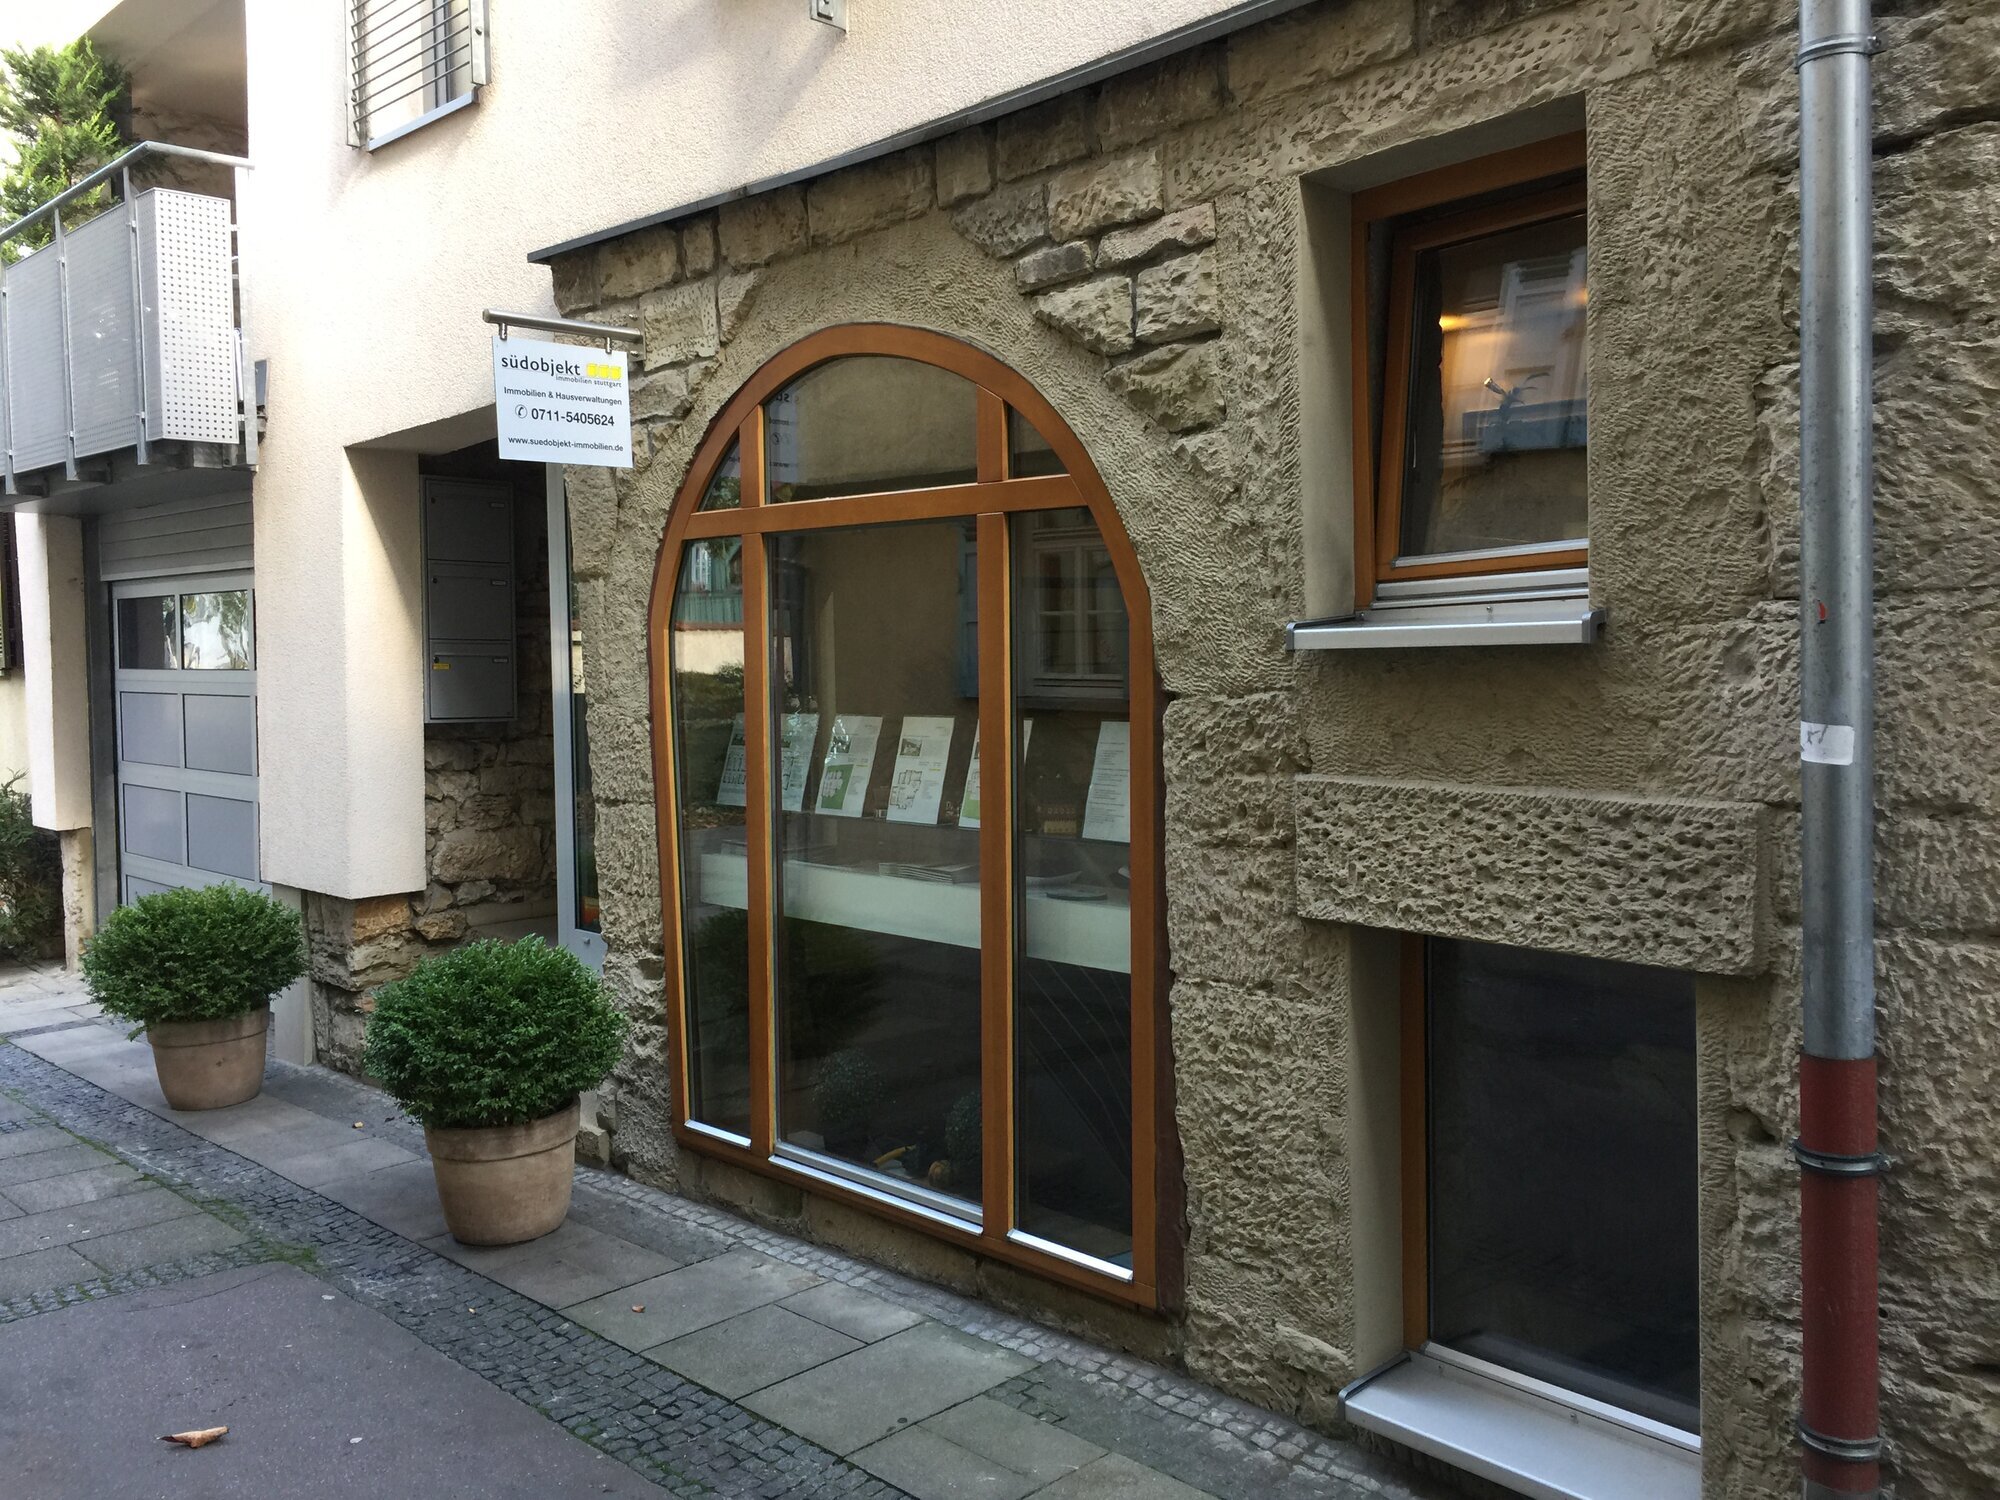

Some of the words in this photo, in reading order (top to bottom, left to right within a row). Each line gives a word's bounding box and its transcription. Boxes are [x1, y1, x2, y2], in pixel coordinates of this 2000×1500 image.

[501, 355, 581, 376] südobjekt
[593, 379, 622, 388] stuttgart
[503, 387, 547, 398] Immobilien
[548, 391, 554, 399] &
[555, 392, 622, 406] Hausverwaltungen
[531, 408, 615, 426] 0711-5405624
[508, 437, 624, 452] www.suedobjekt-immobilien.de
